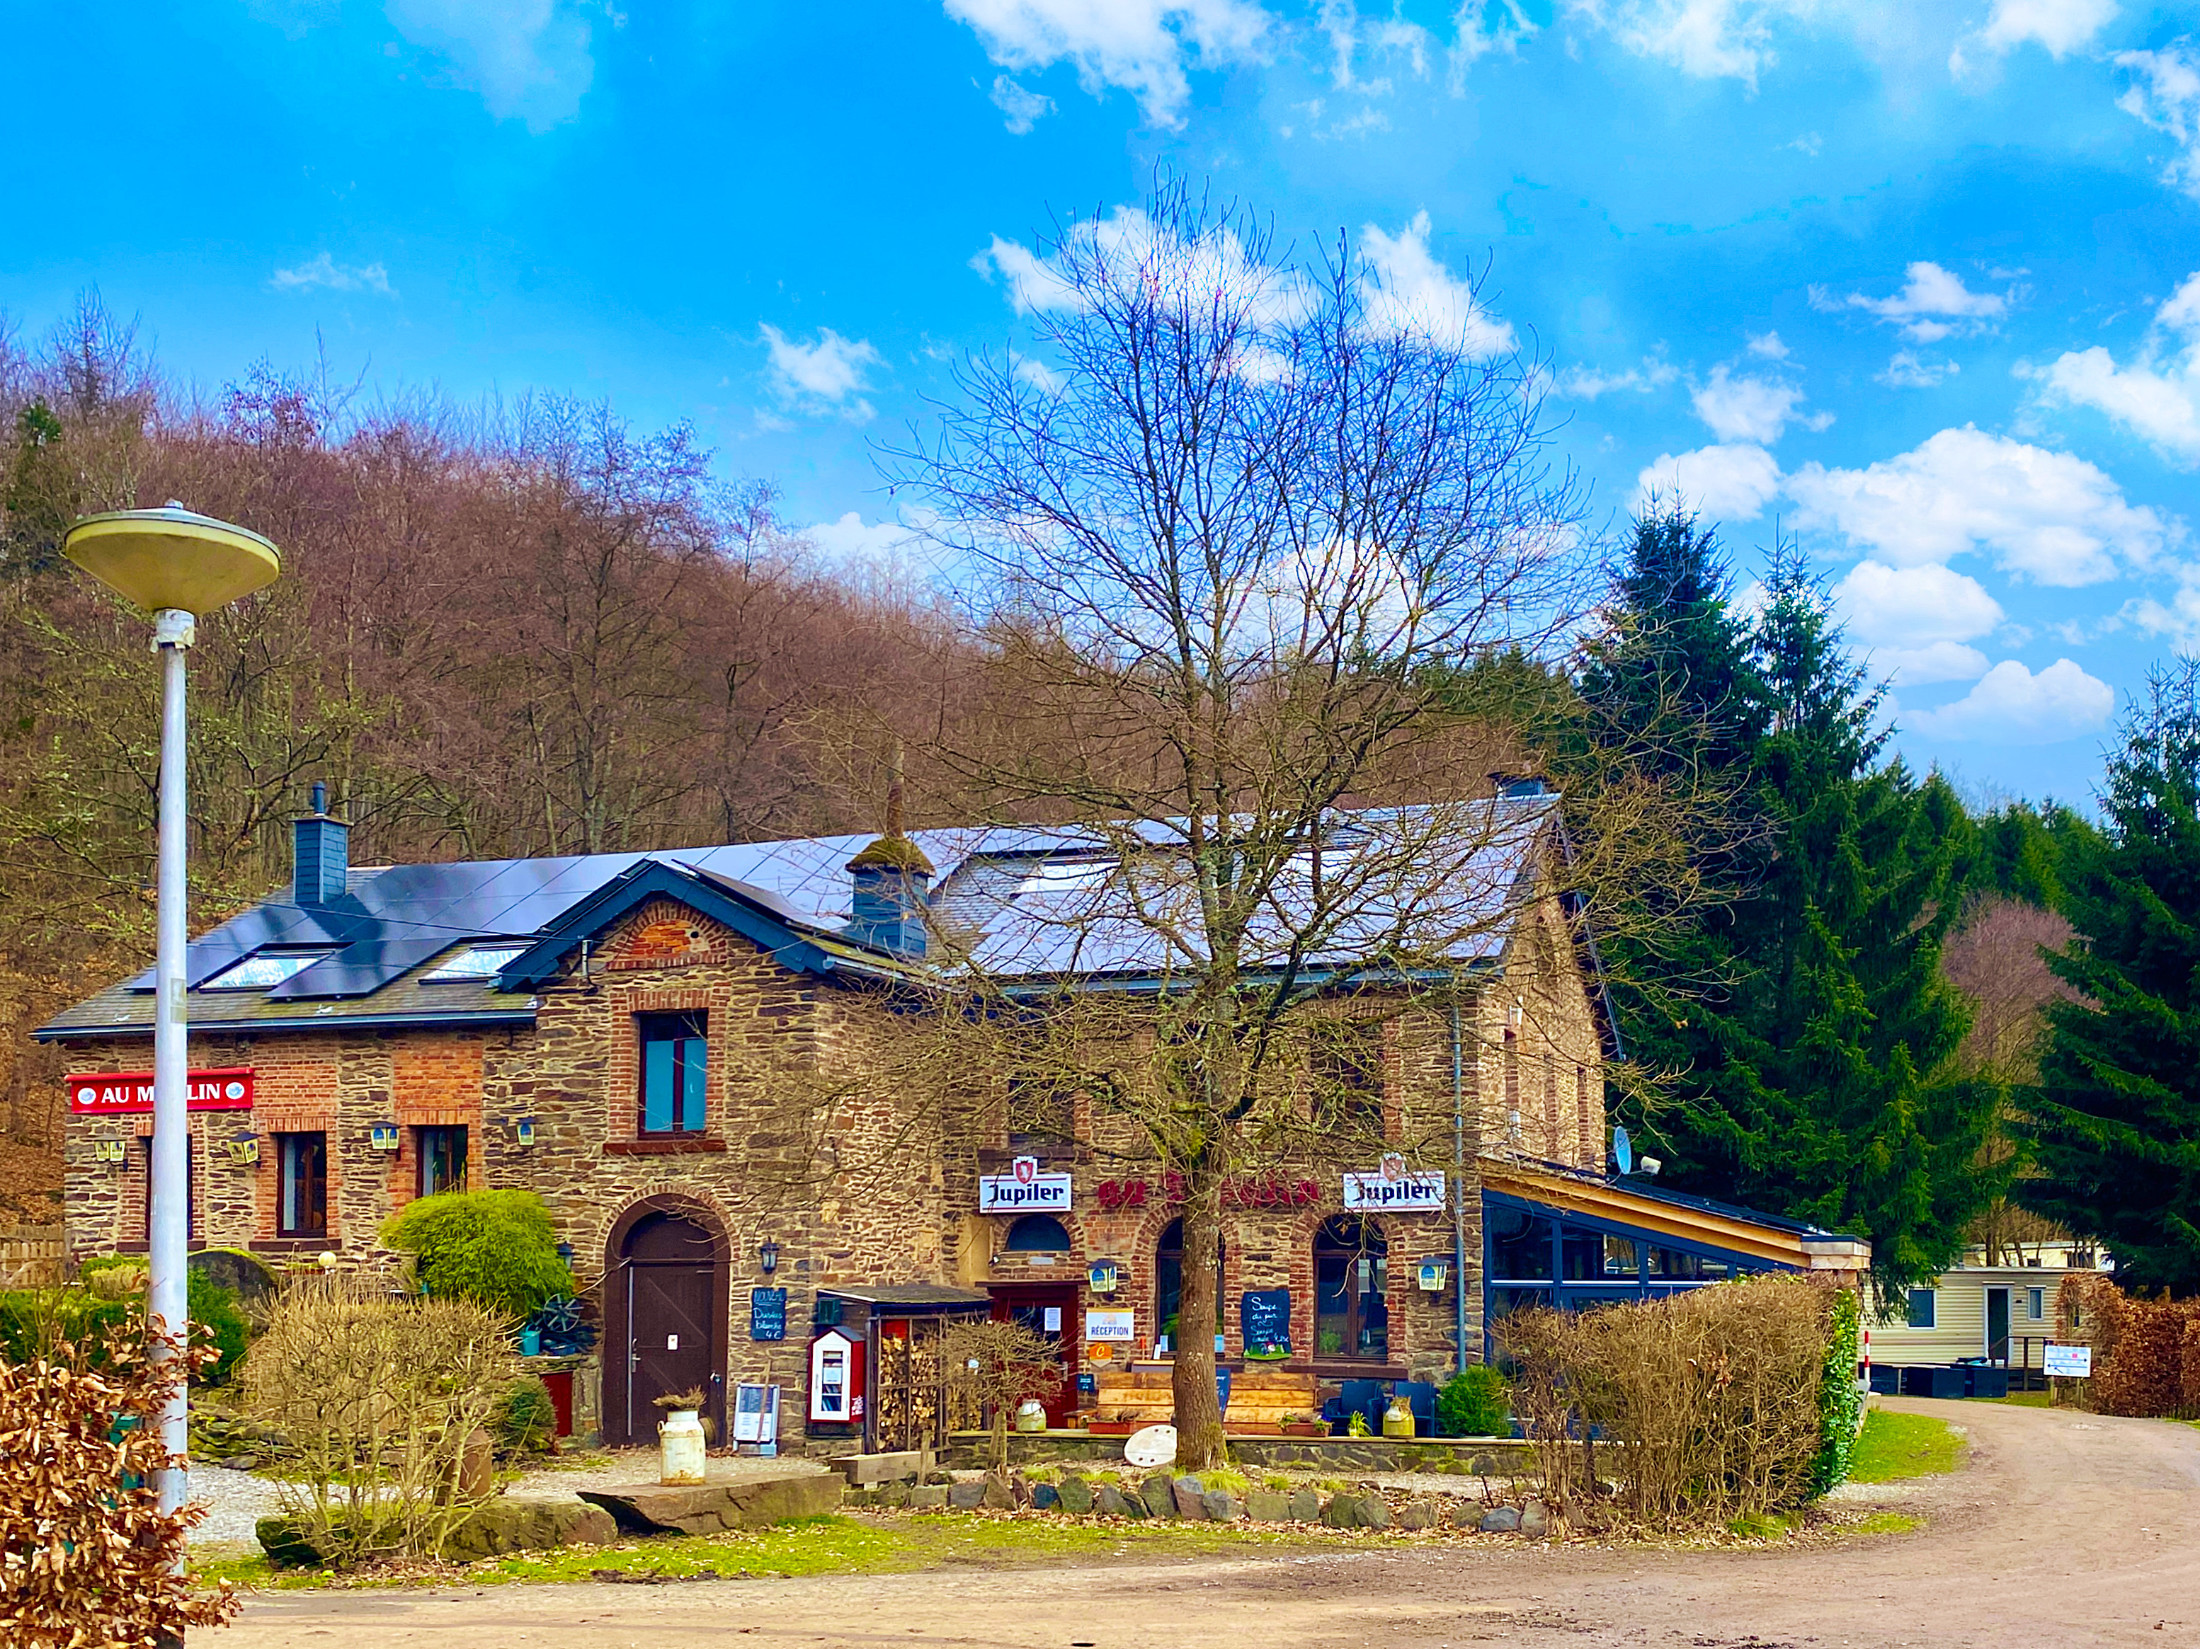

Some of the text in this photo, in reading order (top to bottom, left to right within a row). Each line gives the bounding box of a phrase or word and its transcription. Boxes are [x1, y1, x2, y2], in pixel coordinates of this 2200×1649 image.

[101, 1083, 220, 1103] AU MLIN
[987, 1183, 1064, 1206] Jupiler
[1353, 1181, 1437, 1205] Jupiler
[1091, 1325, 1129, 1336] RÉCEPTION
